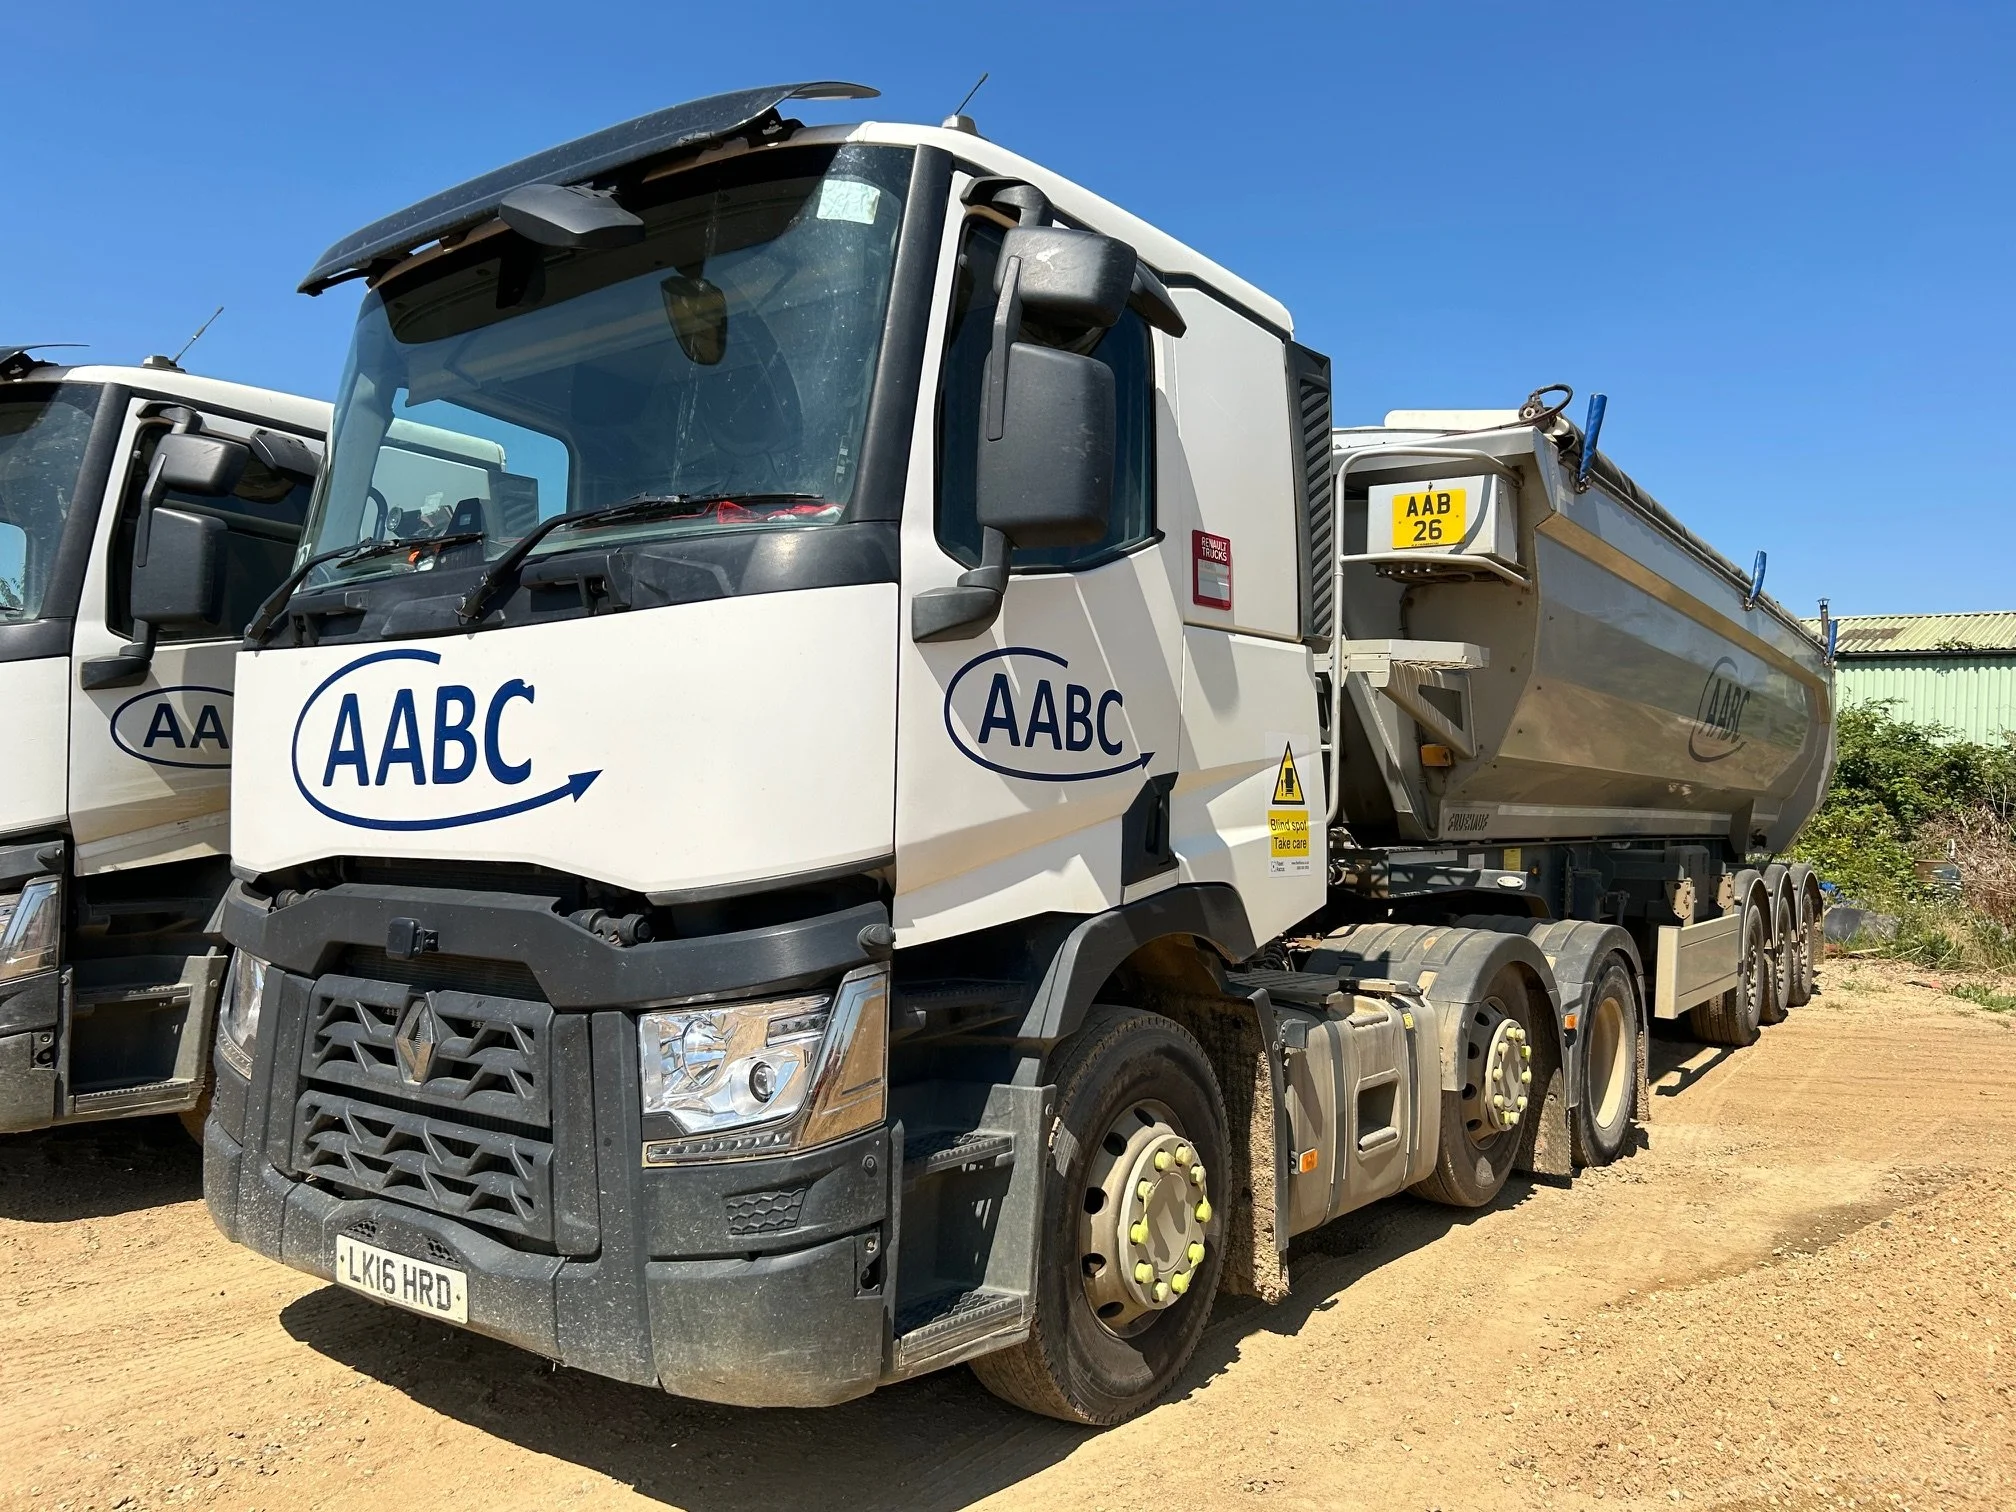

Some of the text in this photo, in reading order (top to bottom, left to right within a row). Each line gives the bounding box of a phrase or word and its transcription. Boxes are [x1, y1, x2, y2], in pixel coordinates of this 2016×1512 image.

[1406, 493, 1451, 517] AAB
[1413, 519, 1442, 541] 26
[1201, 536, 1227, 552] RENAULT
[1201, 546, 1228, 562] TRUCKS
[978, 673, 1123, 755] AABC
[1698, 678, 1751, 744] AABC
[322, 678, 535, 786] AABC
[1270, 818, 1308, 834] Blind spot
[1447, 813, 1490, 831] FRUEHAUF
[1273, 836, 1308, 850] Take care
[348, 1245, 452, 1311] LK16 HRD
